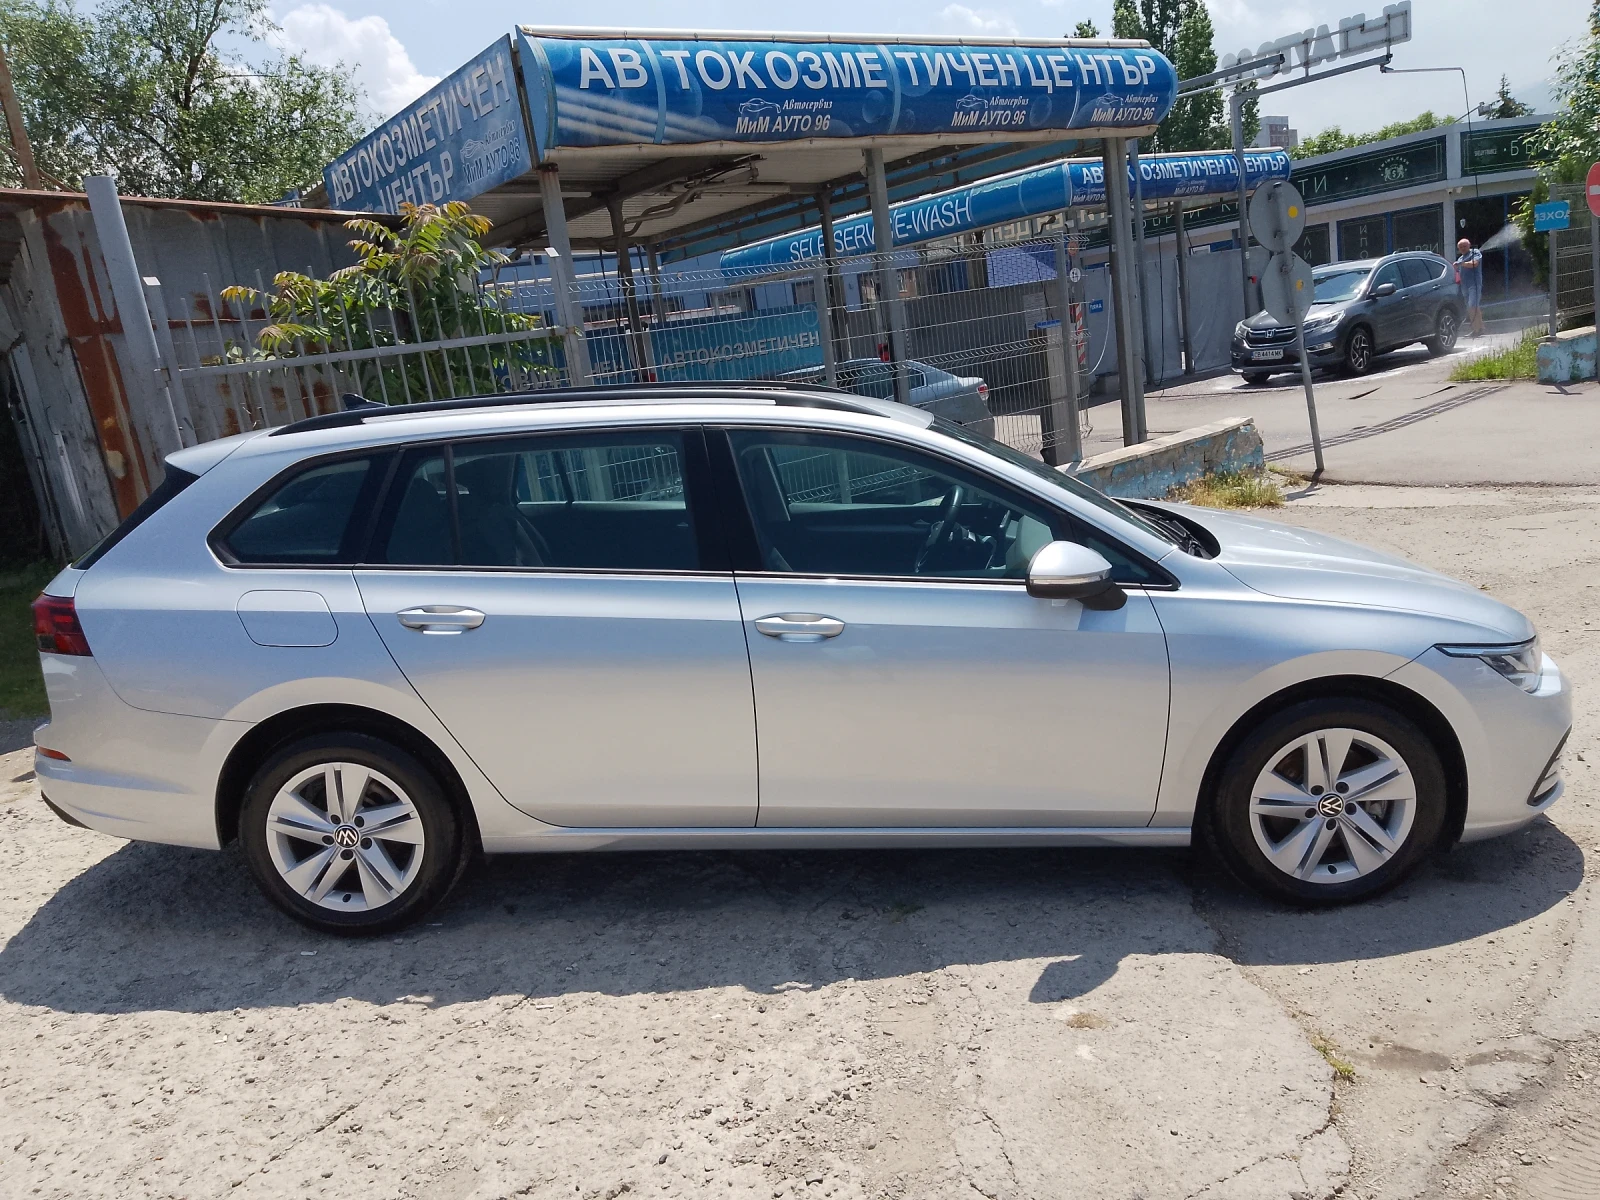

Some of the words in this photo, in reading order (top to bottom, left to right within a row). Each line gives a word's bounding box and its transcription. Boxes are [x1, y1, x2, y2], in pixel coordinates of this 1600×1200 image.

[783, 98, 833, 112] Автосервиз
[989, 95, 1029, 108] Автосервиз
[951, 111, 979, 127] МиМ
[978, 110, 1011, 126] АУТО
[1011, 110, 1027, 125] 96
[1091, 107, 1115, 122] МиМ
[1114, 107, 1142, 122] АУТО
[1141, 107, 1155, 121] 96
[330, 52, 511, 207] АВТОКОЗМЕТИЧЕН
[735, 116, 770, 134] МиМ
[771, 114, 812, 133] АУТО
[814, 114, 831, 131] 96
[485, 144, 508, 175] АУТО
[508, 137, 520, 164] 96
[662, 330, 821, 371] АВТОКОЗМЕТИЧЕН
